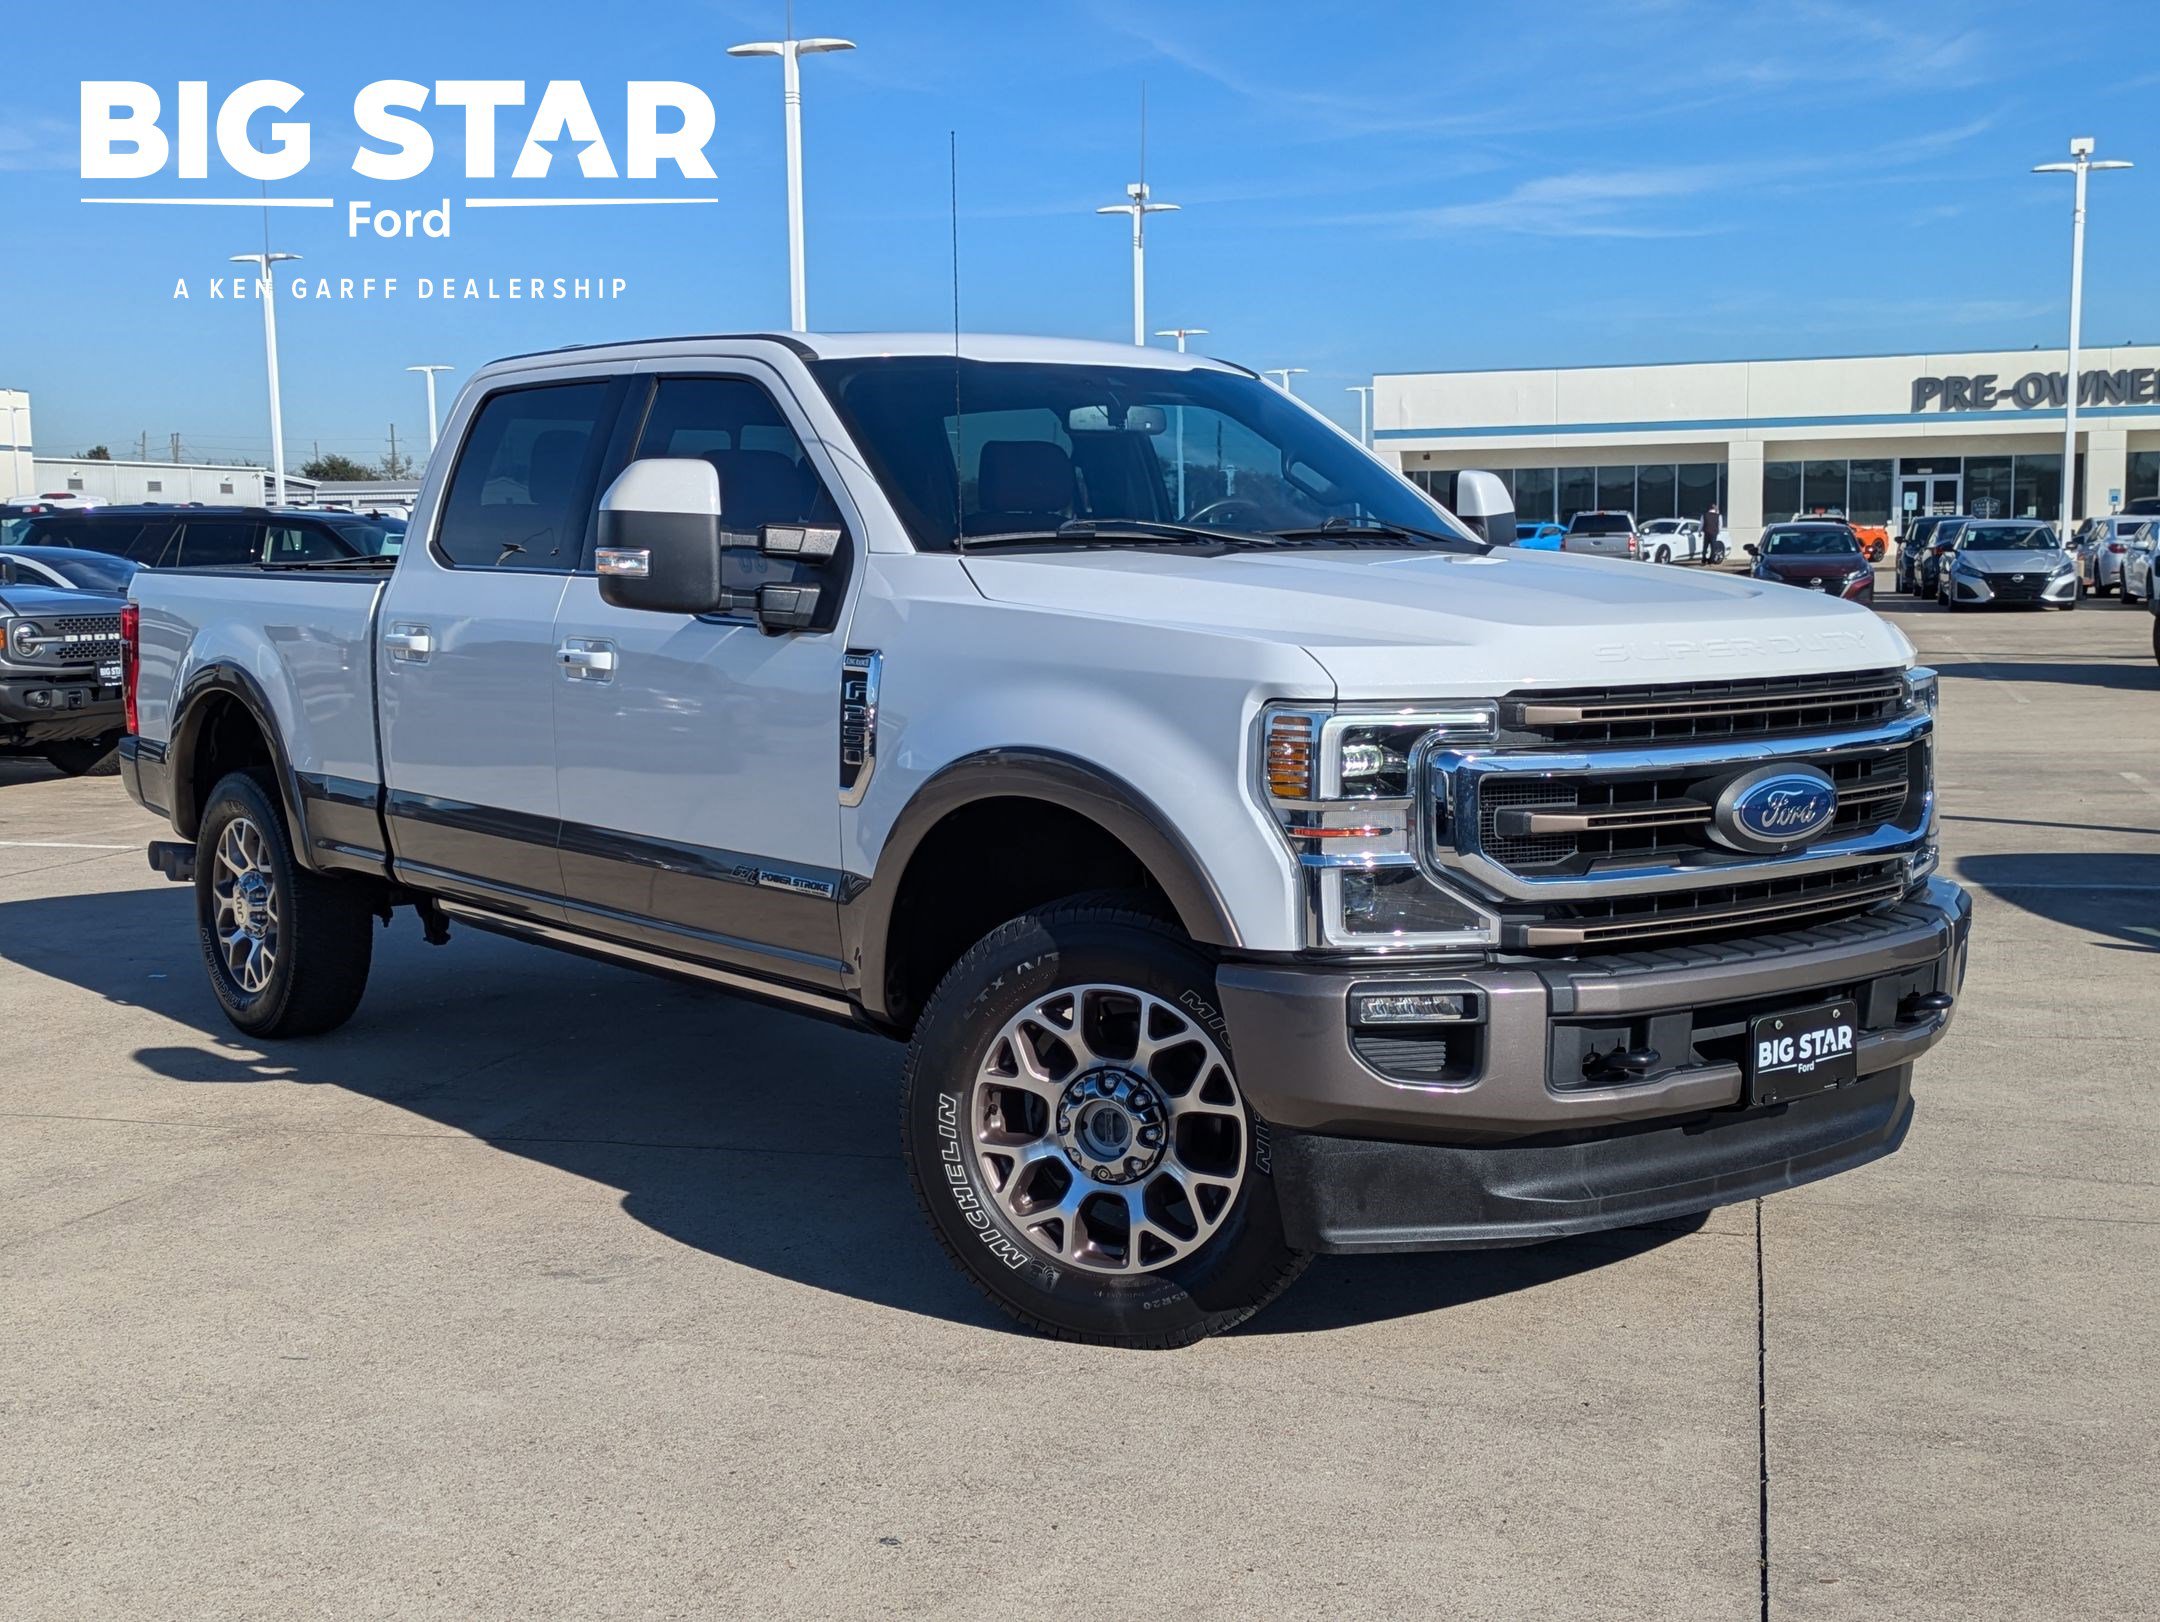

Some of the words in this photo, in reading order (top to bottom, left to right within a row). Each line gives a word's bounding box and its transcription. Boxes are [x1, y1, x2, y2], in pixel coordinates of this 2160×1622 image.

[1911, 367, 2160, 412] PRE-OWNE
[64, 632, 120, 643] BRON
[1592, 639, 1765, 663] SUPER
[1767, 630, 1867, 655] DUTY
[1761, 790, 1817, 828] Ford
[760, 872, 792, 885] POWER
[792, 878, 830, 892] STROKE
[1758, 1036, 1795, 1069] BIG
[1799, 1024, 1853, 1060] STAR
[1797, 1060, 1816, 1074] Ford
[938, 1092, 1028, 1270] MICHELIN
